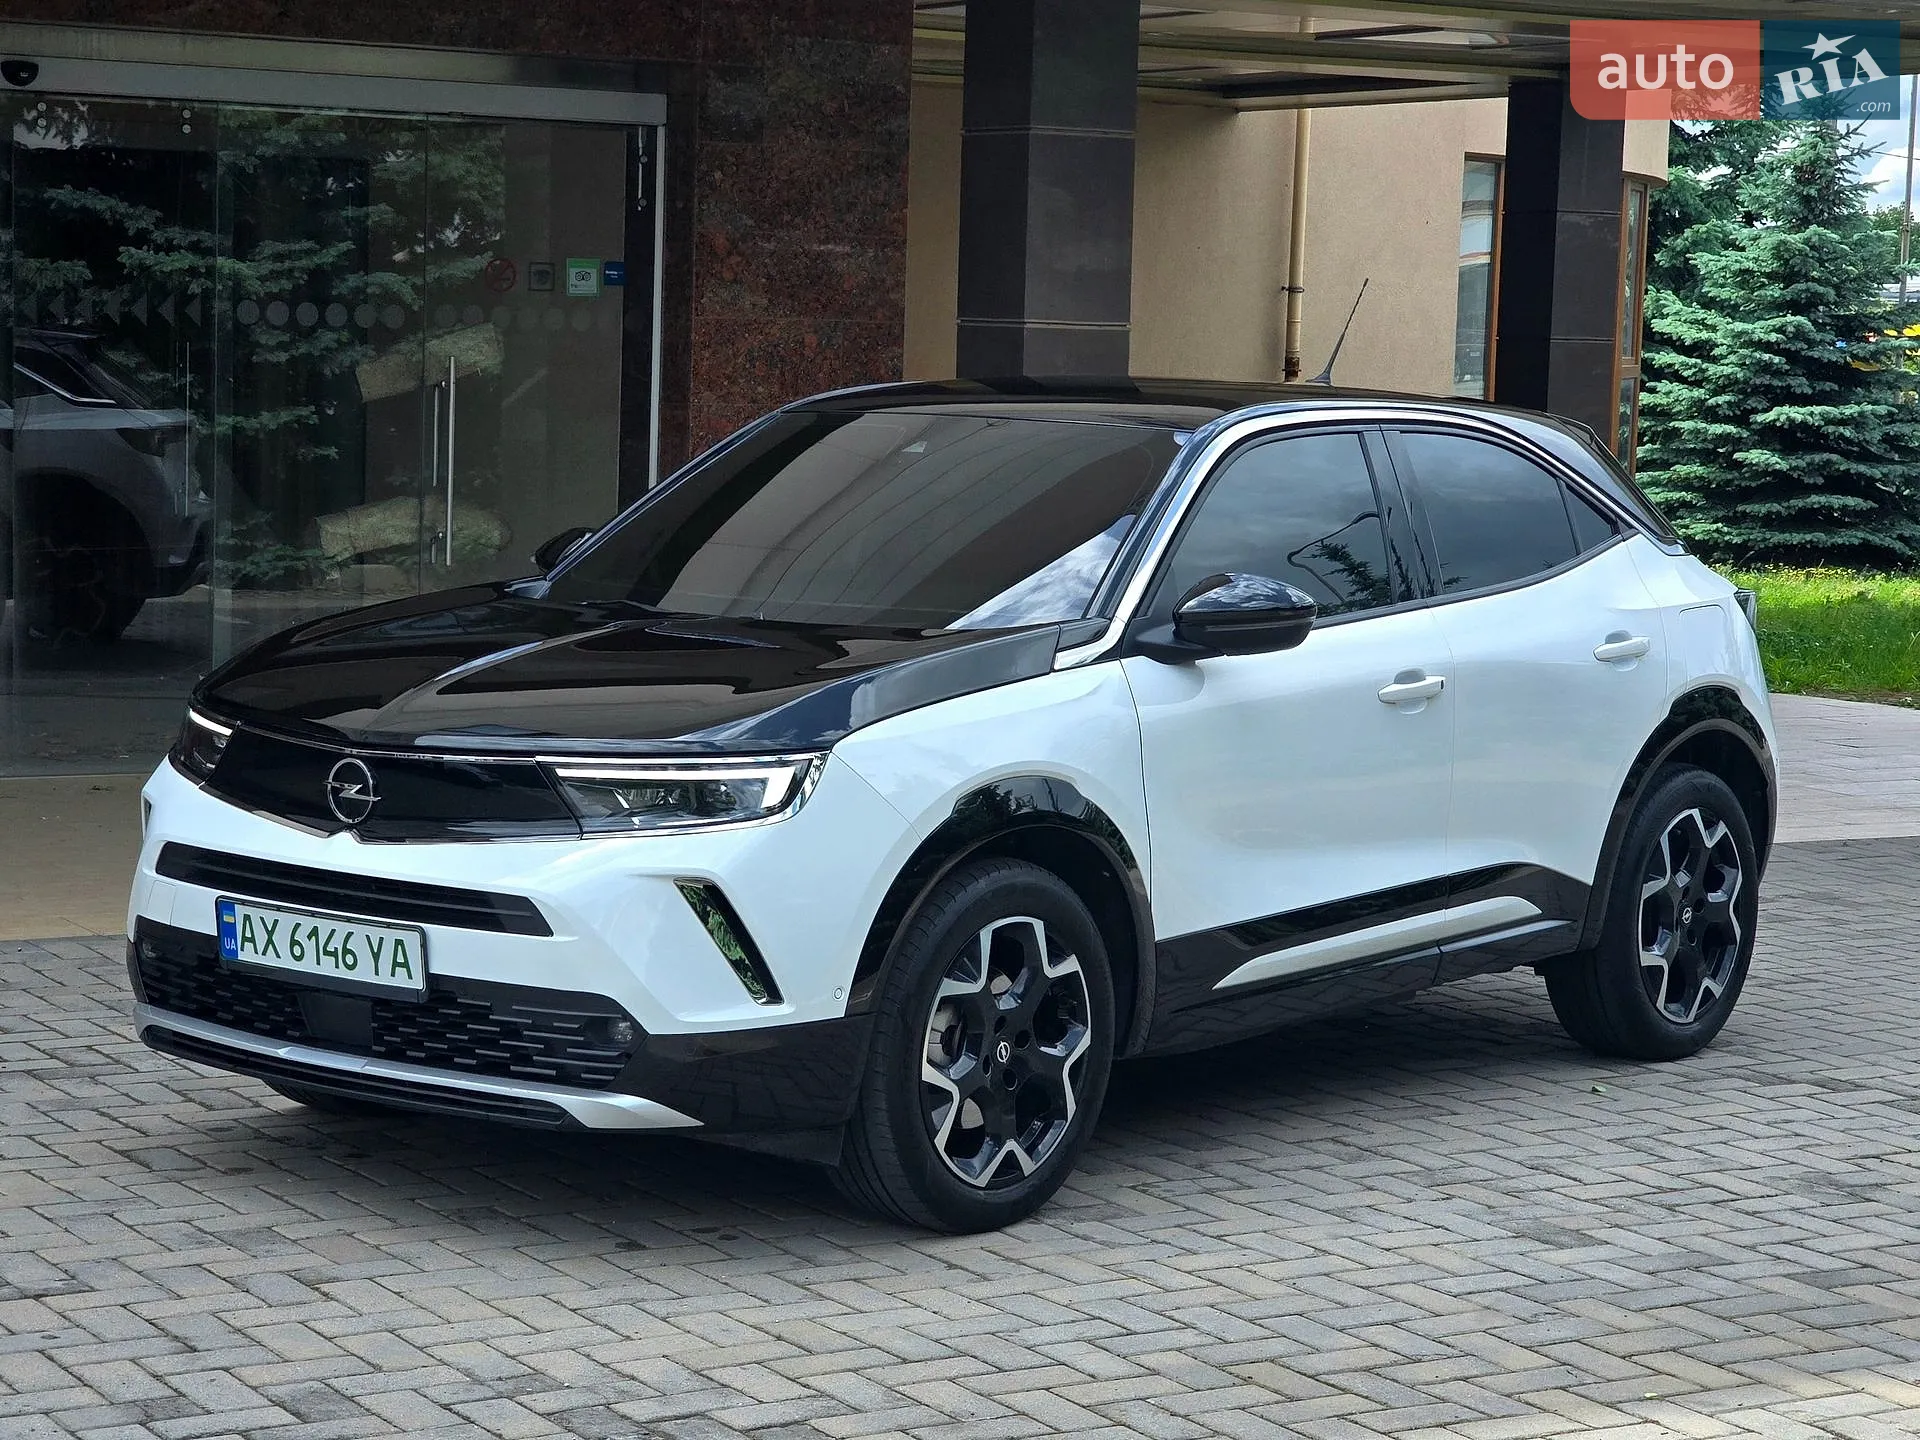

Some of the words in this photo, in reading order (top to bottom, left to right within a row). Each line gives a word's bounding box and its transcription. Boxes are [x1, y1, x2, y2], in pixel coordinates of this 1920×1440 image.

[224, 936, 237, 951] UA
[239, 913, 282, 959] AX
[289, 922, 358, 971] 6146
[365, 934, 414, 980] YA
